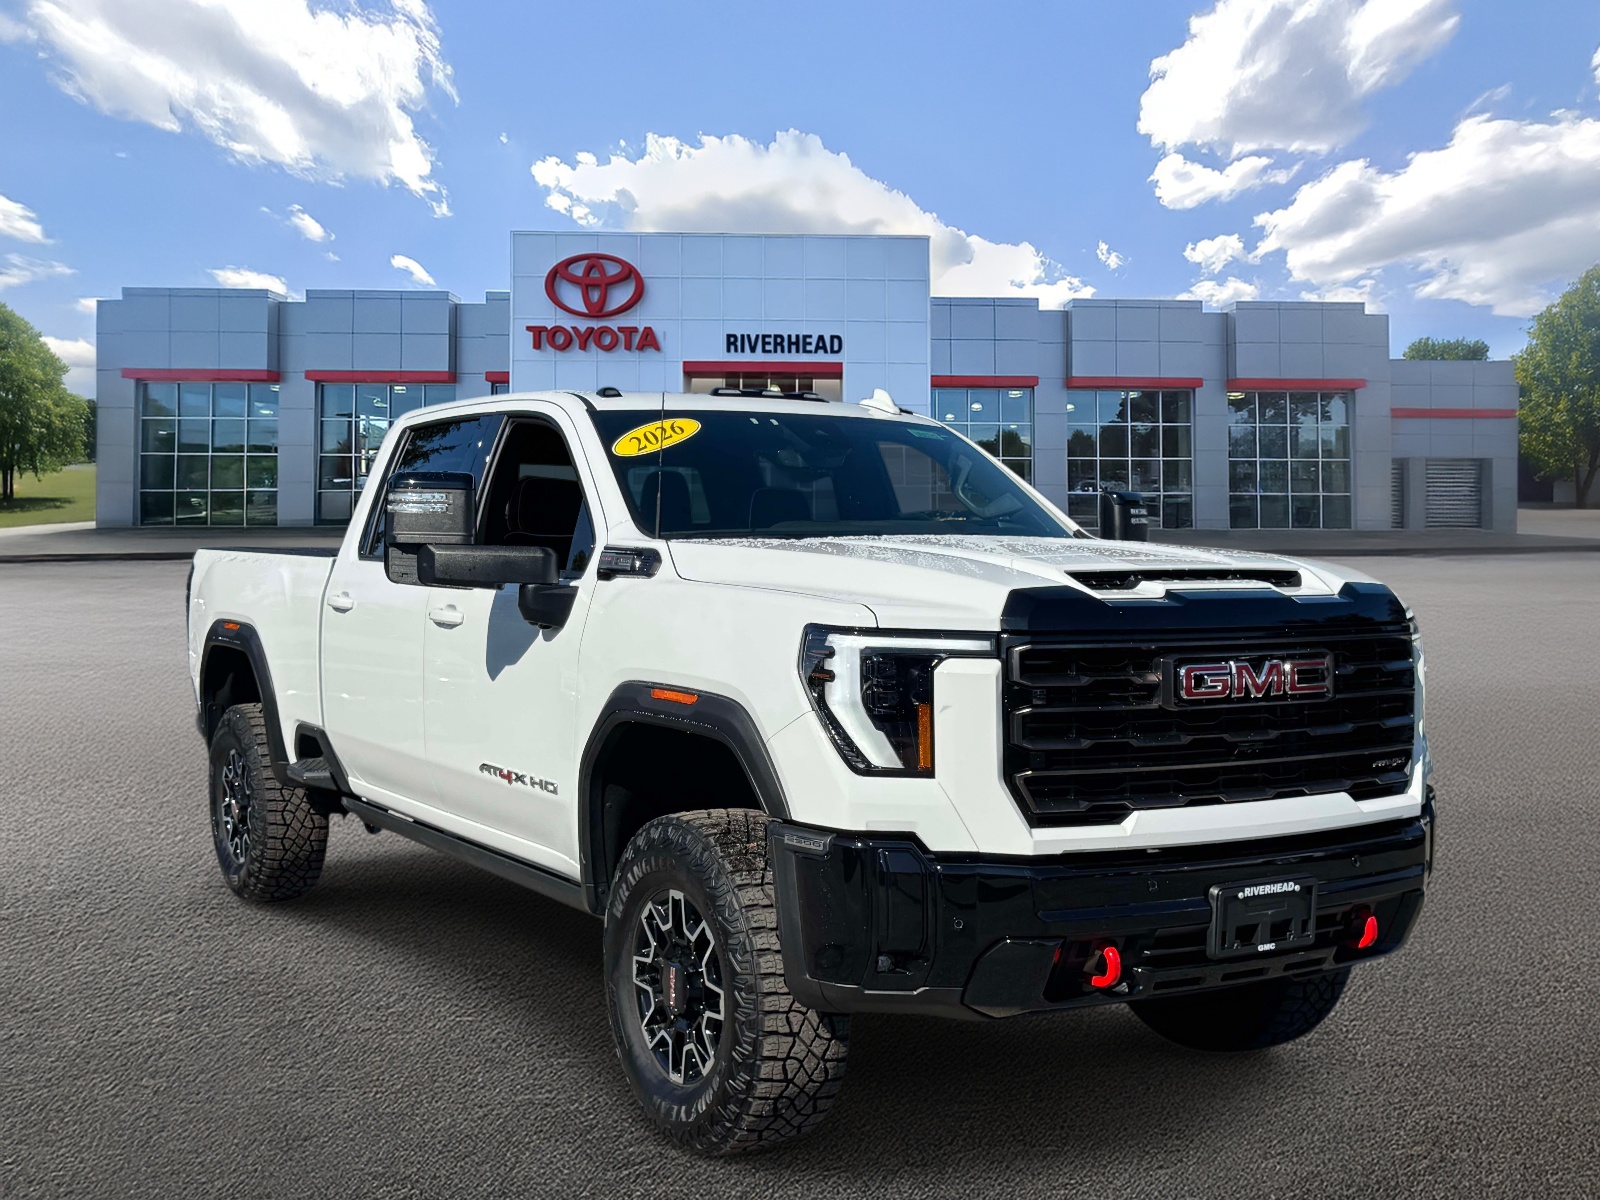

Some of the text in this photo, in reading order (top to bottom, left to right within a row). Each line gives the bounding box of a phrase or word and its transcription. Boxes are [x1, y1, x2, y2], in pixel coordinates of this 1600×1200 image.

[526, 325, 661, 352] TOYOTA
[726, 333, 843, 355] RIVERHEAD
[628, 420, 686, 454] 2026
[1179, 660, 1328, 699] GMC
[479, 763, 559, 796] AT4X HD
[613, 856, 676, 919] WRANGLER
[1244, 882, 1295, 898] RIVERHEAD
[1257, 943, 1276, 952] GMC
